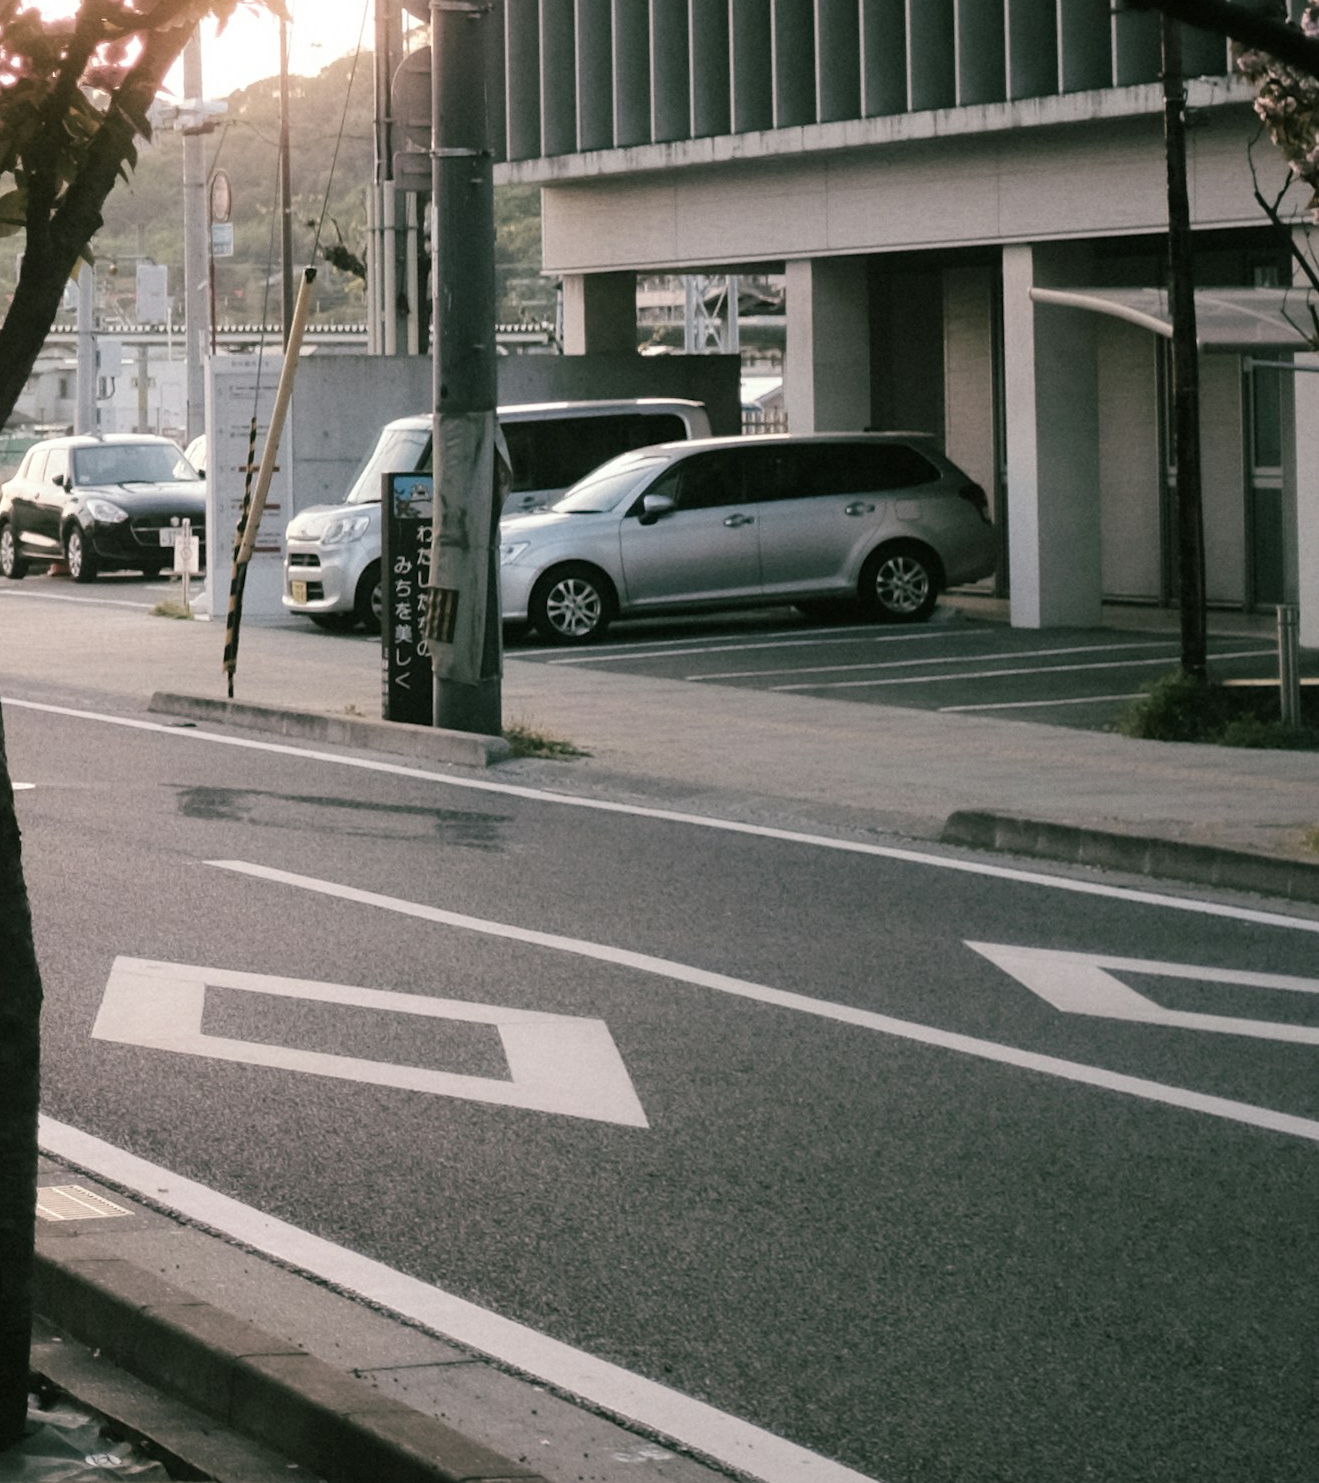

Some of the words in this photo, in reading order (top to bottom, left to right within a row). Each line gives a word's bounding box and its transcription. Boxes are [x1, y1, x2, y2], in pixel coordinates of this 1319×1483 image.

[393, 555, 413, 690] みちを美しく
